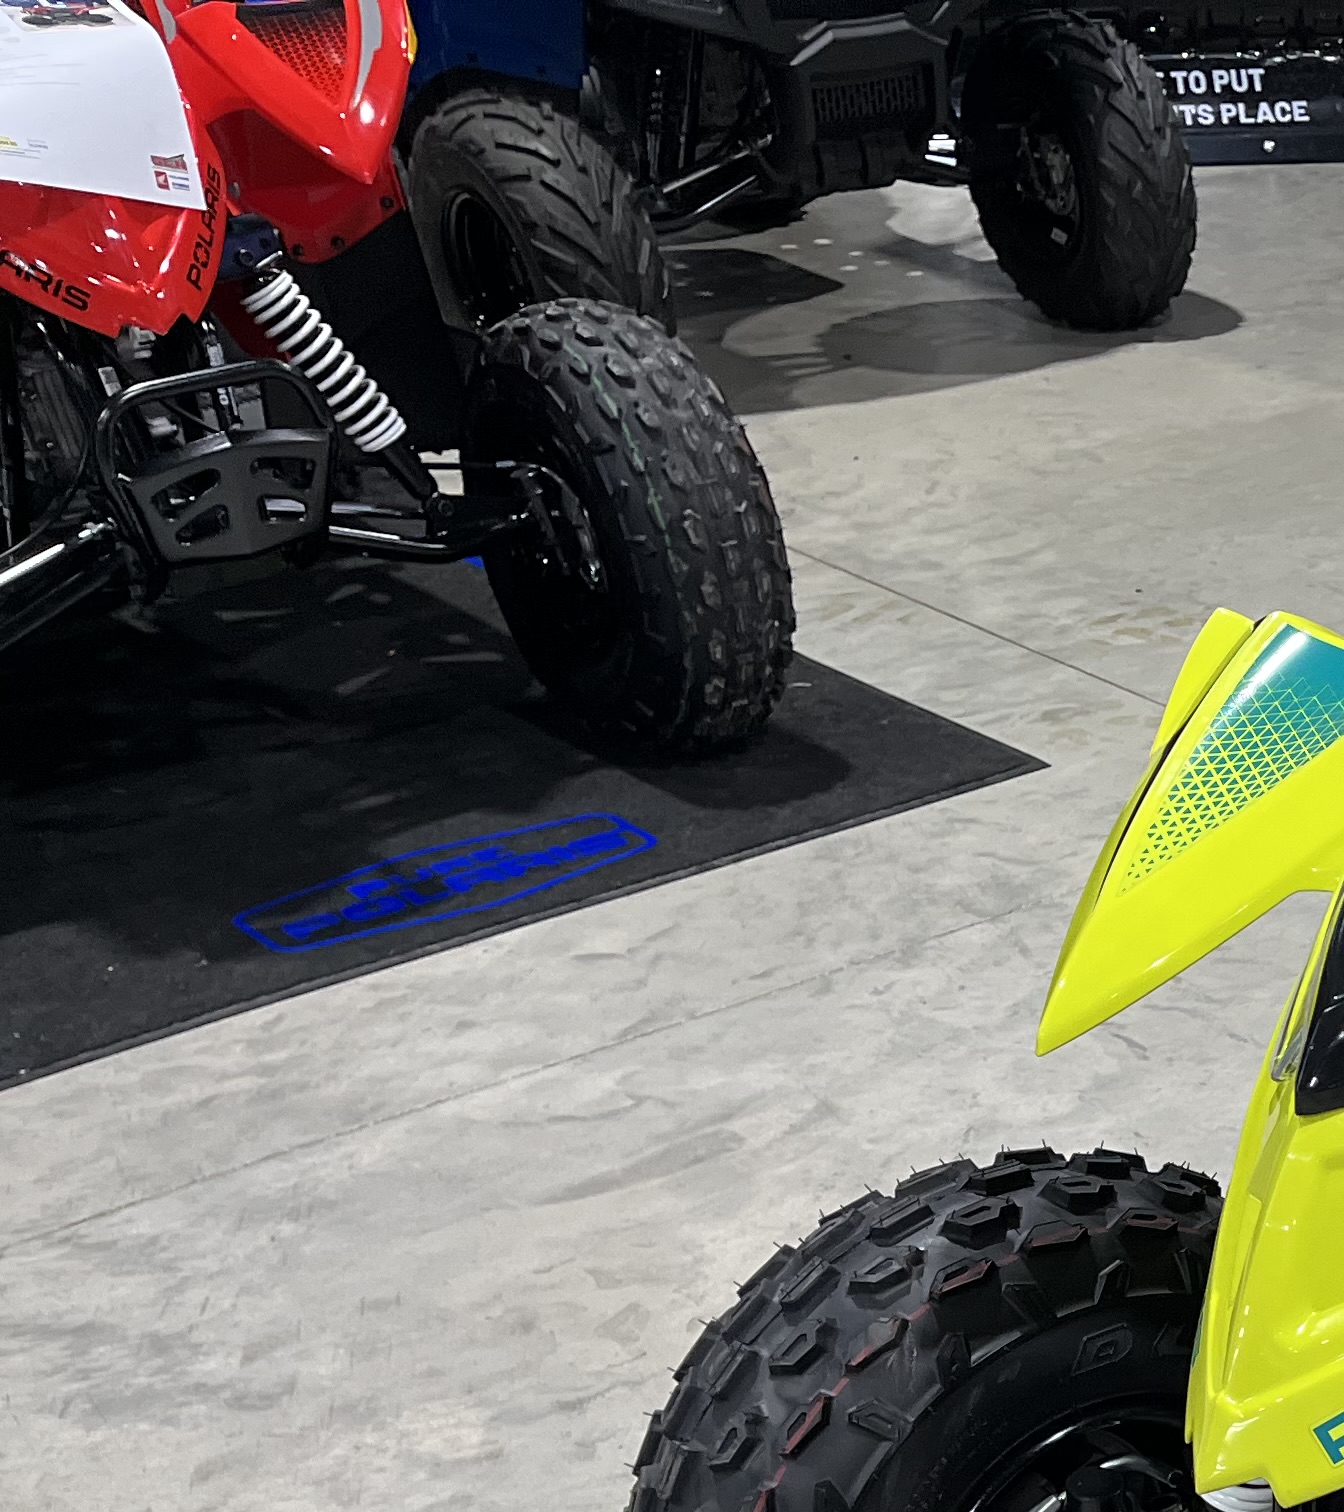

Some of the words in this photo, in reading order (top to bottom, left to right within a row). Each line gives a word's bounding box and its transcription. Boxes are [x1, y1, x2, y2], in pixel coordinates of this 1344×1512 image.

[1170, 69, 1208, 94] TO
[1212, 67, 1265, 93] PUT
[1220, 100, 1310, 125] PLACE
[186, 164, 221, 291] POLARIS
[282, 830, 629, 942] POLARIS
